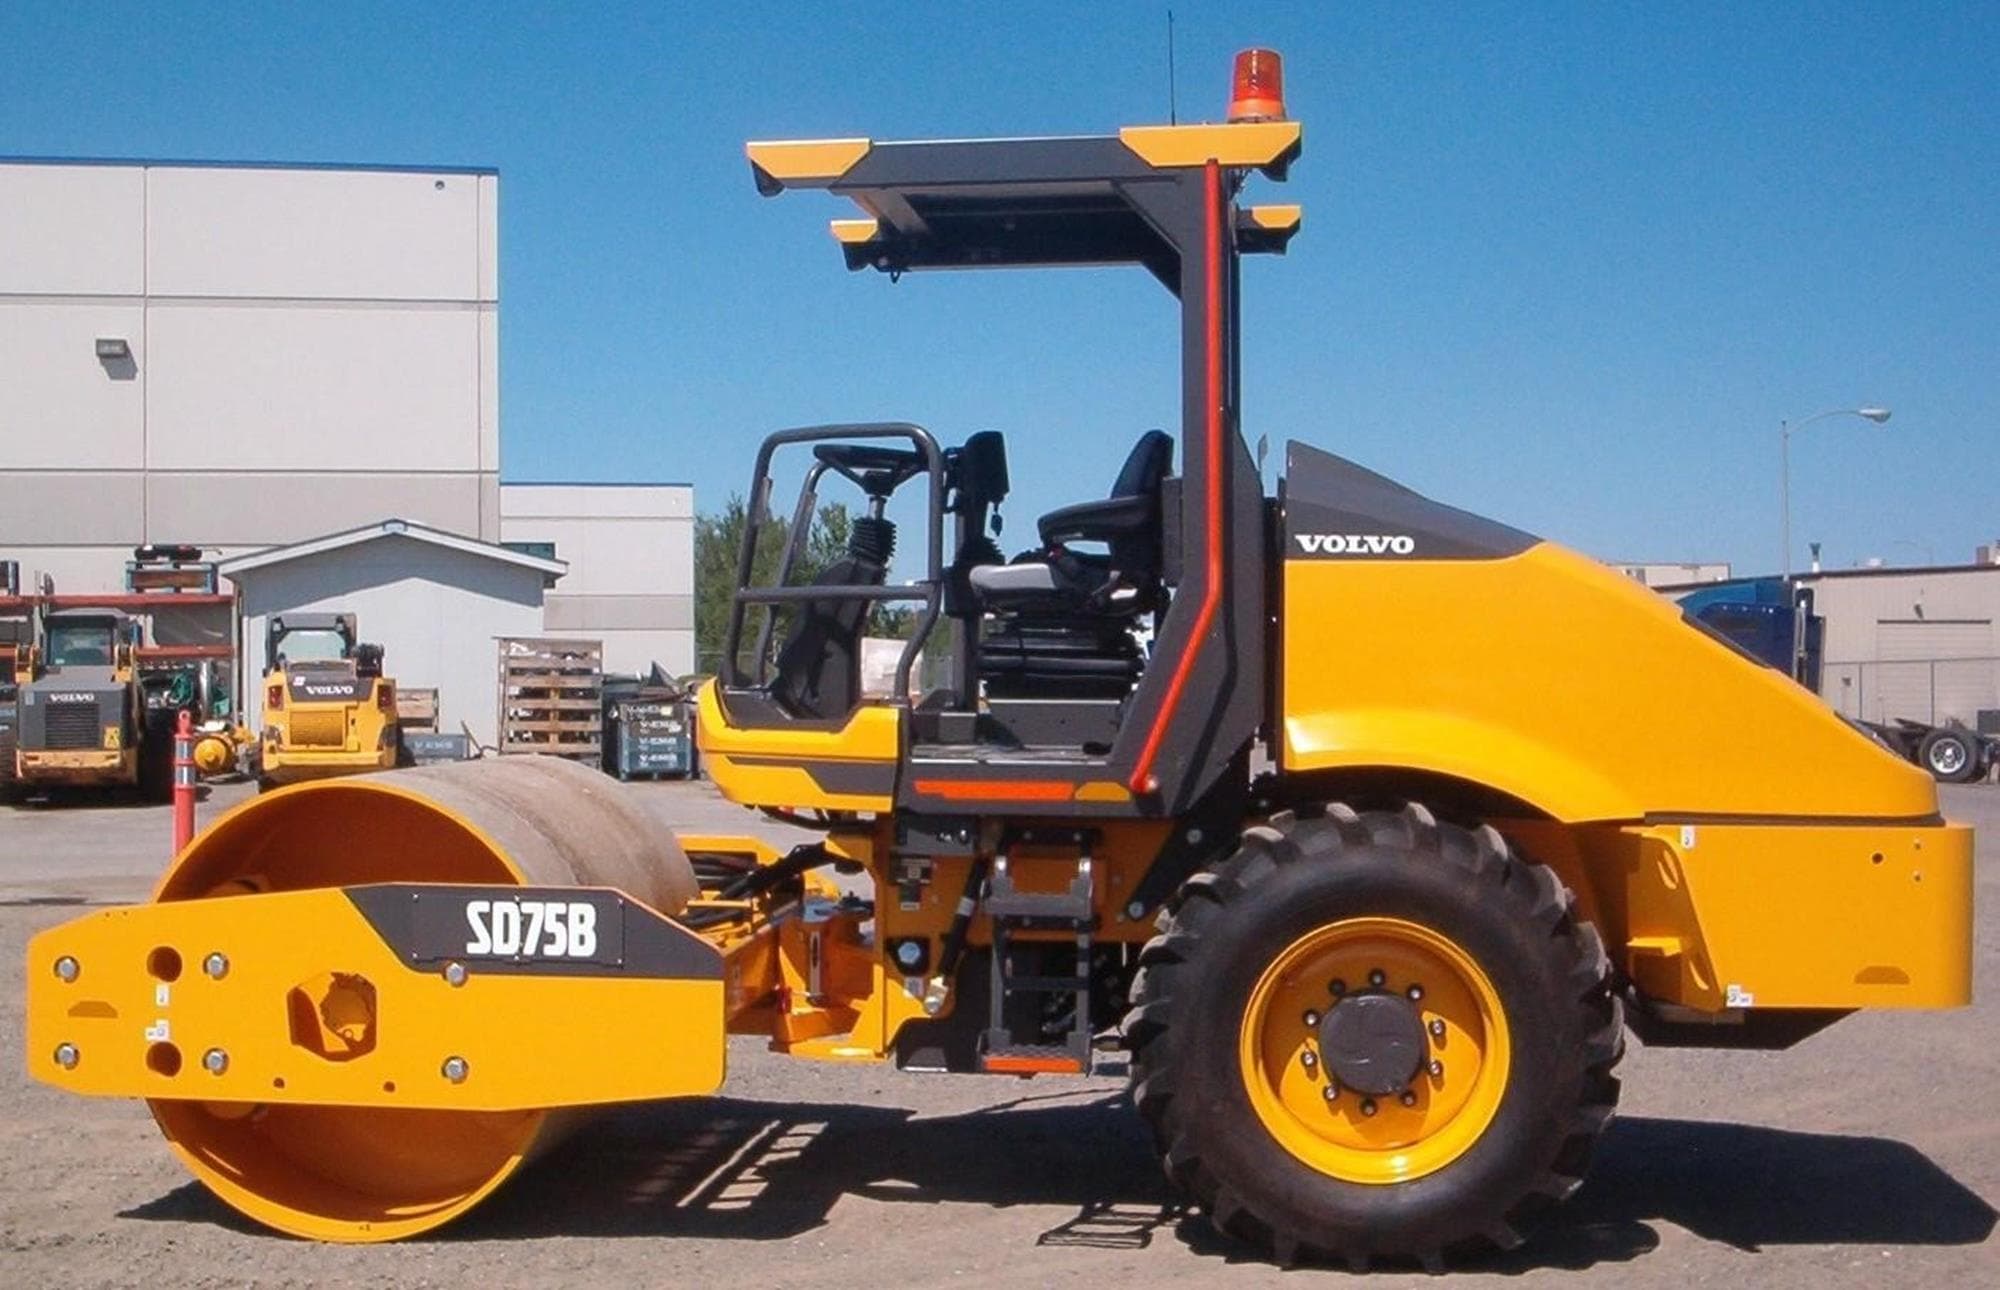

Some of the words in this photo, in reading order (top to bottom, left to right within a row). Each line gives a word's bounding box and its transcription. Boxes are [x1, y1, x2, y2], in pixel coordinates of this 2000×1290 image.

[1295, 534, 1415, 554] VOLVO
[50, 693, 95, 702] VOLVO
[305, 685, 354, 695] VOLVO
[466, 901, 597, 957] SD75B
